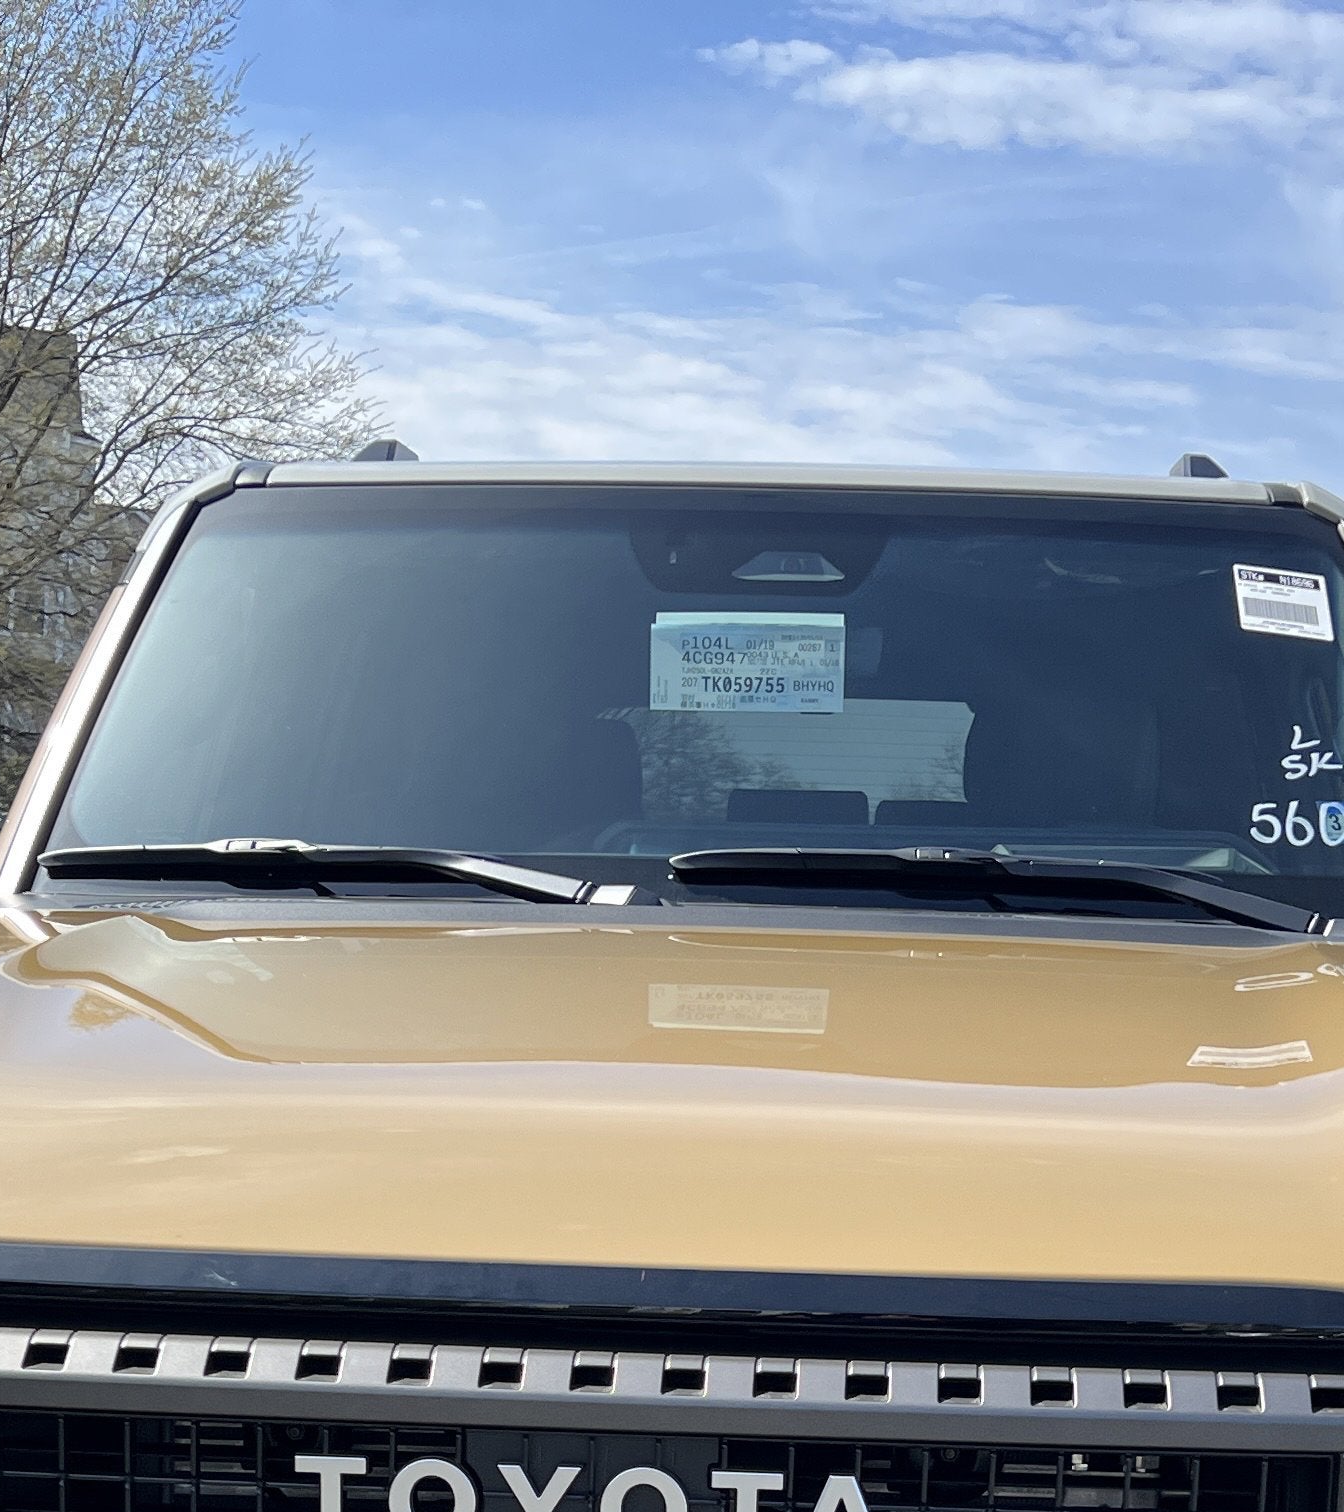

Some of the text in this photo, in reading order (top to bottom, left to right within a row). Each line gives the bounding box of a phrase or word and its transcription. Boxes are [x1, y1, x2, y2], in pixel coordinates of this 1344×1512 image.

[681, 651, 747, 665] 4CG947
[681, 676, 834, 694] 207 TK059755 BHYHQ
[1281, 752, 1343, 780] SK
